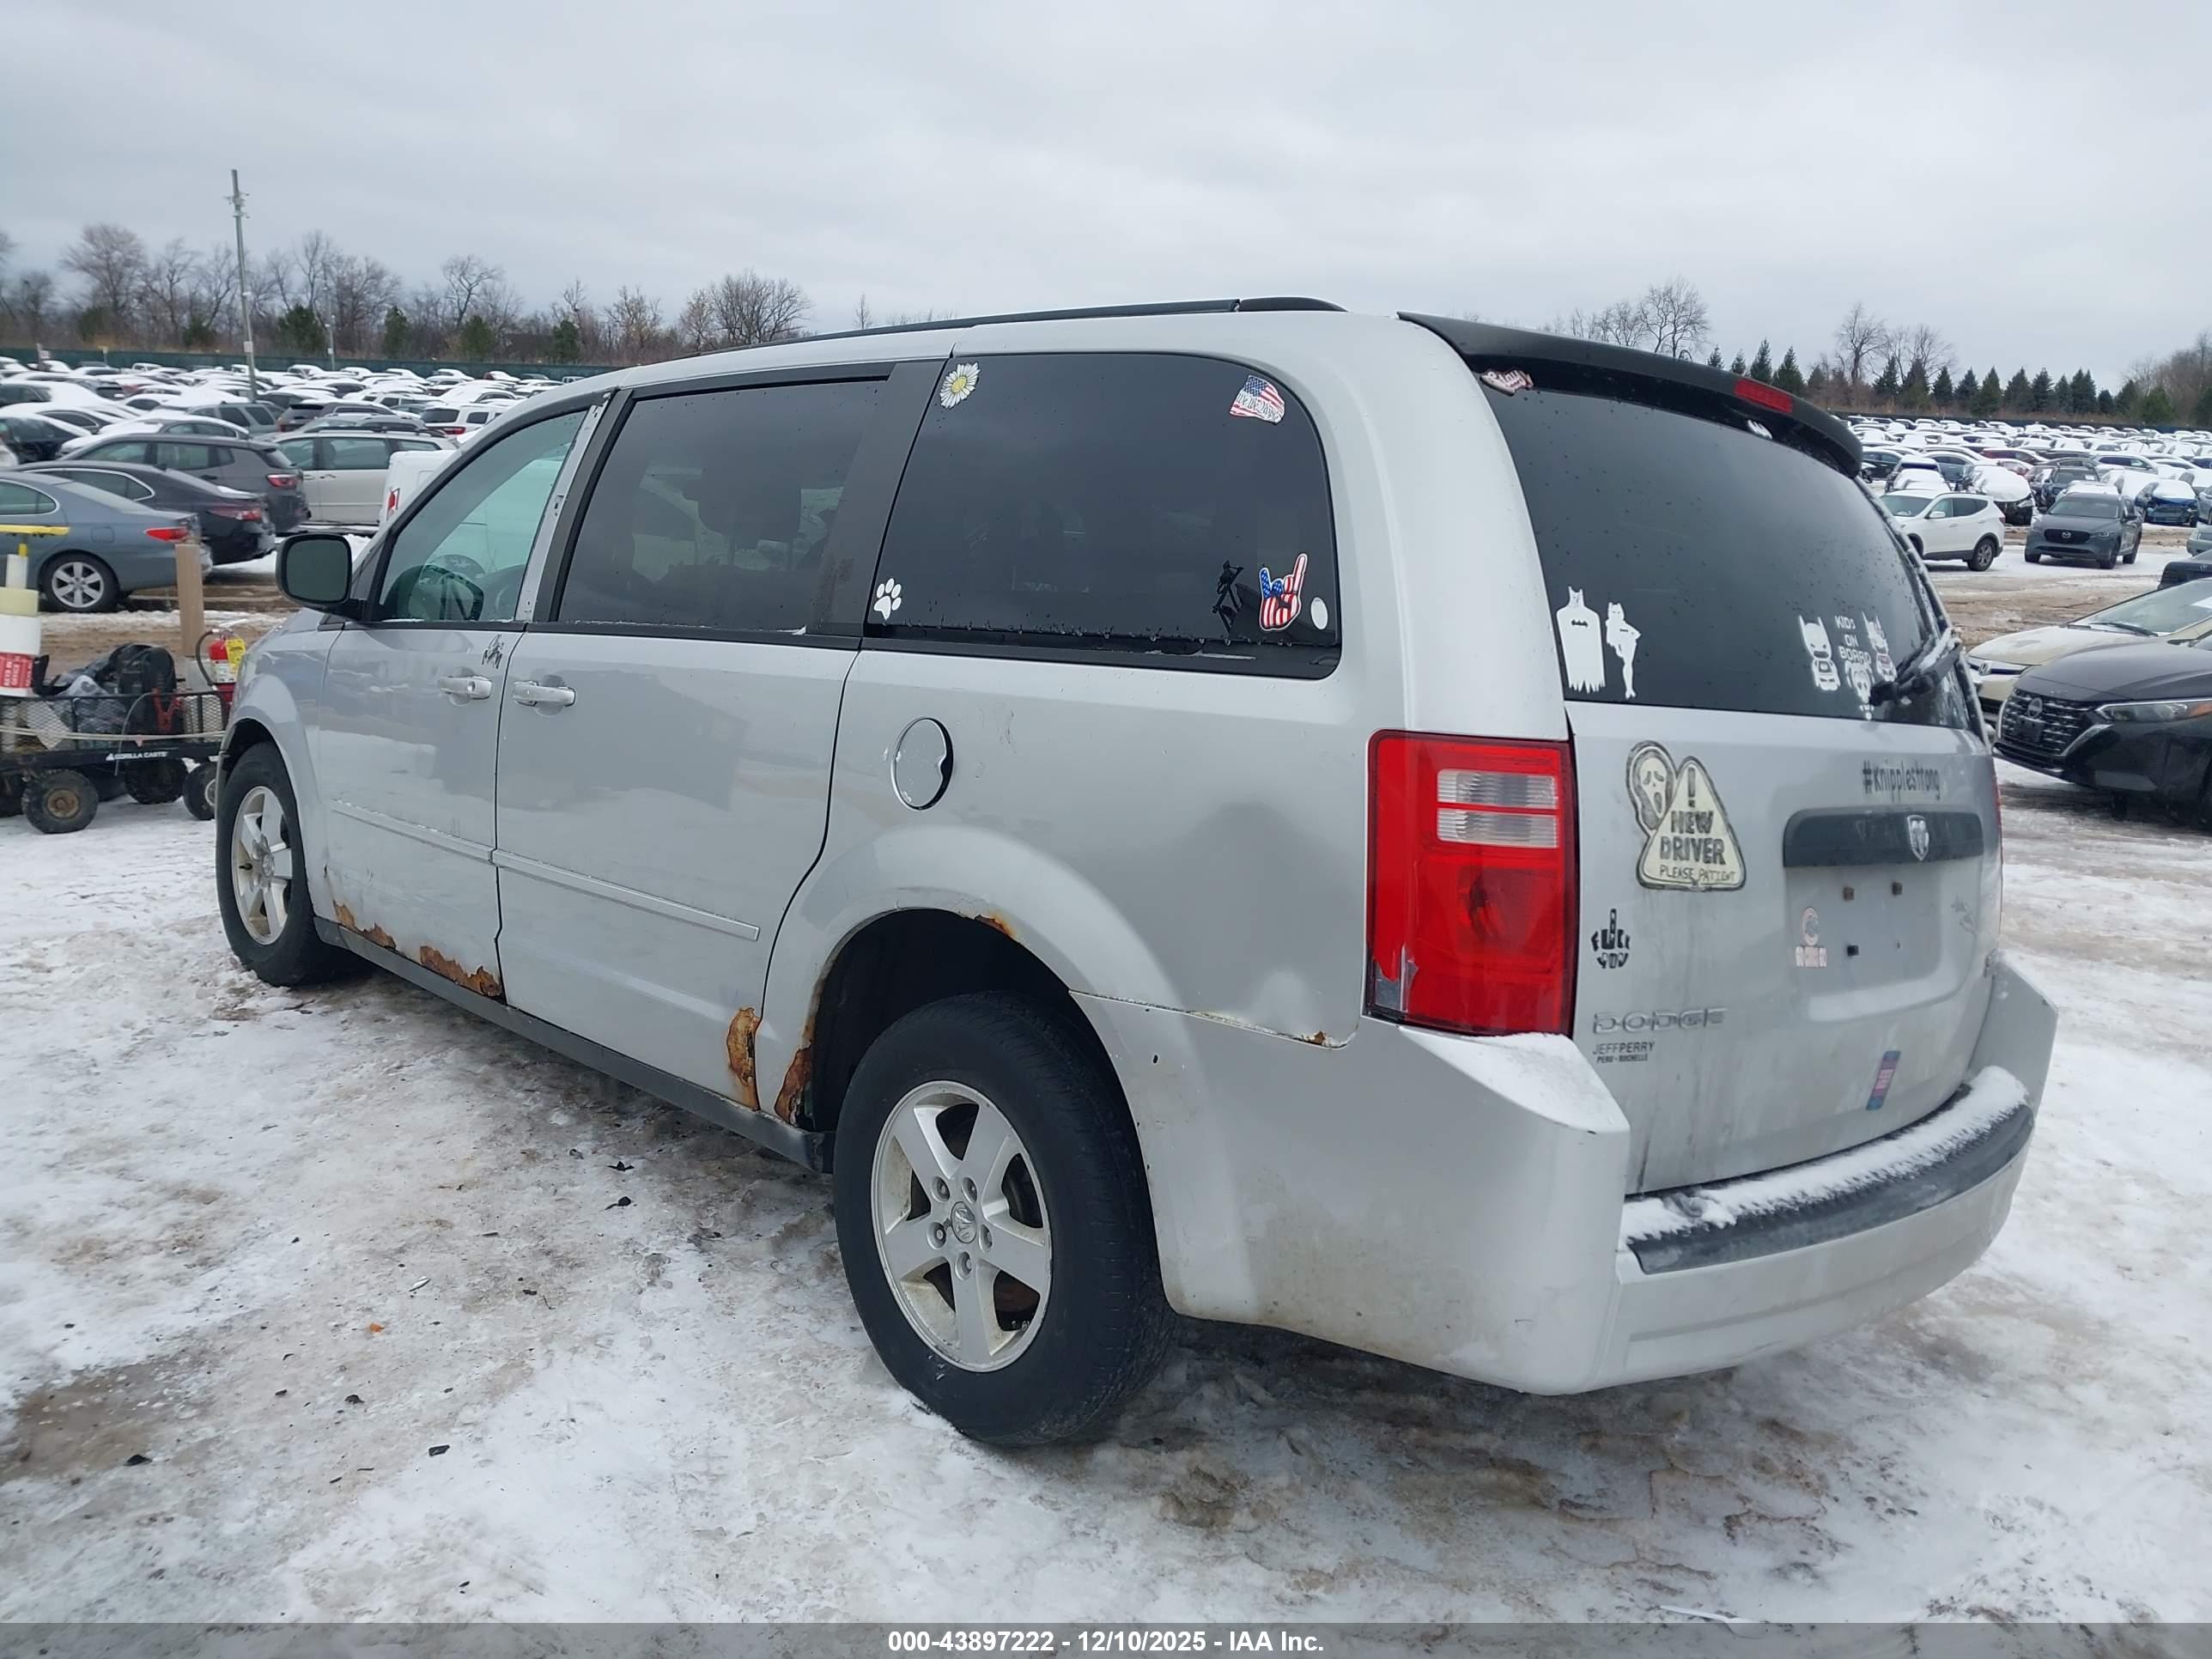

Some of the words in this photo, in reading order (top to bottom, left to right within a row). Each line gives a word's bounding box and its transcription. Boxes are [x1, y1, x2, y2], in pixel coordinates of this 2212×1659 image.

[1834, 615, 1856, 629] KIDS
[1844, 634, 1860, 647] ON
[1838, 645, 1872, 665] BOARD
[1670, 810, 1714, 835] NEW
[1659, 836, 1727, 866] DRIVER
[1592, 1007, 1727, 1035] DODGE
